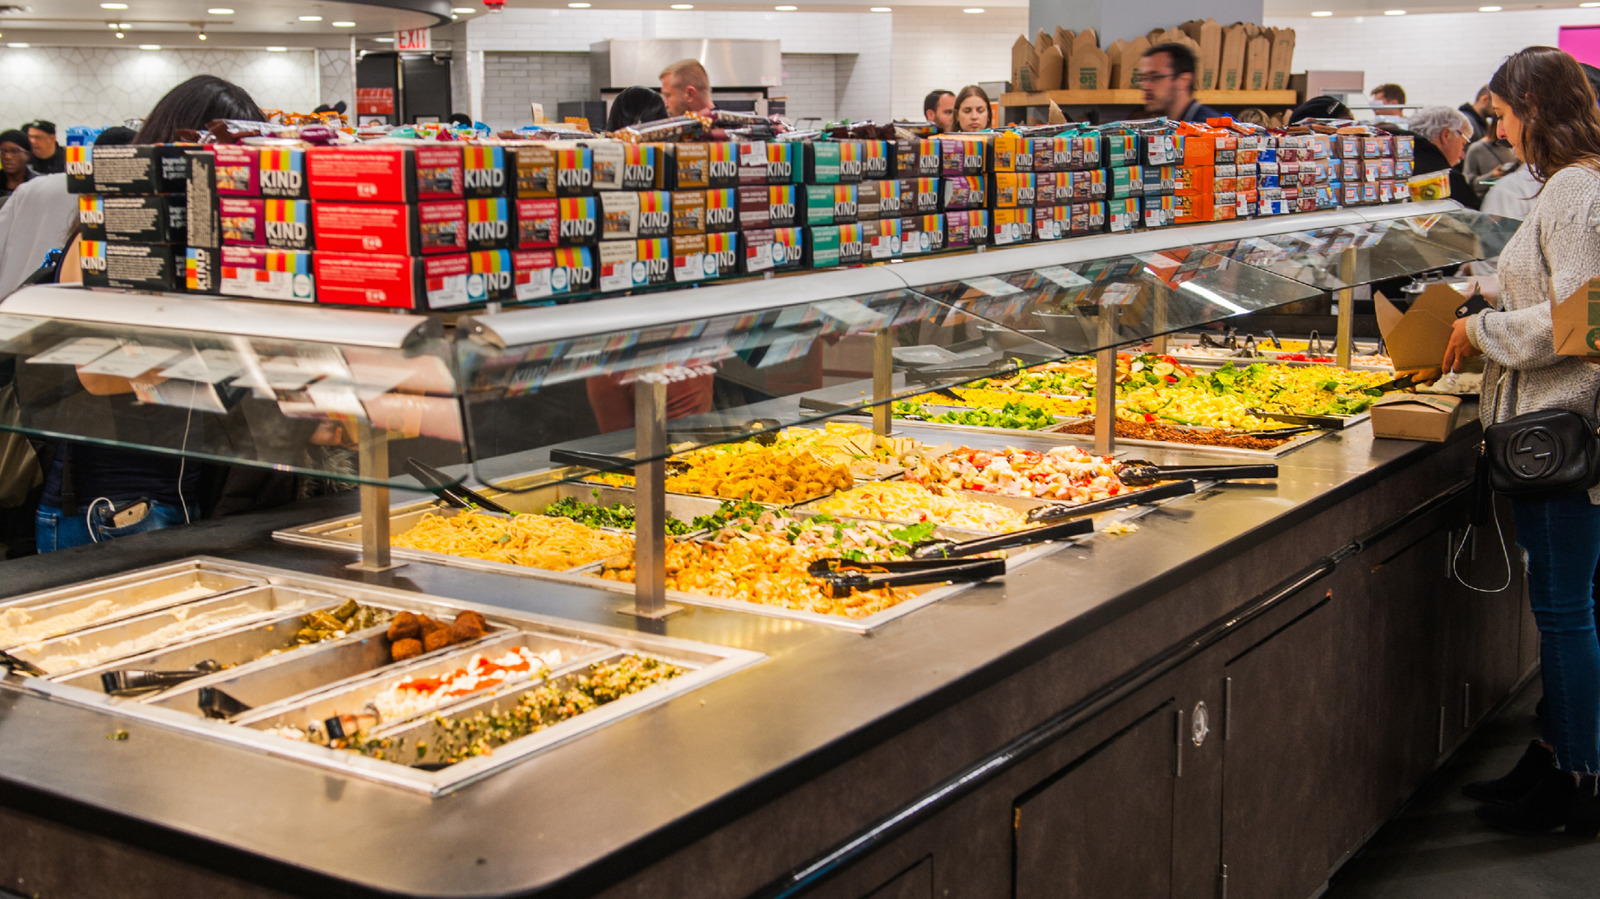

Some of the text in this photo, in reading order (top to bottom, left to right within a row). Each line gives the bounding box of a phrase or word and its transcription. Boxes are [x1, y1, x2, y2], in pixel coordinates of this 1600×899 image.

[398, 28, 428, 49] EXIT
[1015, 154, 1033, 166] KIND
[1054, 152, 1071, 164] KIND
[1084, 152, 1099, 163] KIND
[1124, 149, 1136, 159] KIND
[66, 161, 93, 175] KIND
[767, 161, 791, 176] KIND
[840, 161, 861, 175] KIND
[867, 157, 887, 171] KIND
[920, 155, 939, 168] KIND
[964, 155, 982, 168] KIND
[624, 165, 654, 180] KIND
[710, 161, 736, 177] KIND
[260, 170, 302, 188] KIND
[464, 169, 504, 188] KIND
[557, 168, 591, 187] KIND
[1130, 179, 1143, 190] KIND
[1161, 179, 1175, 189] KIND
[1018, 188, 1035, 199] KIND
[1056, 186, 1073, 198] KIND
[1092, 183, 1106, 194] KIND
[880, 197, 900, 211] KIND
[918, 192, 937, 206] KIND
[969, 191, 984, 204] KIND
[770, 204, 795, 219] KIND
[835, 201, 857, 215] KIND
[80, 211, 104, 224] KIND
[640, 212, 670, 228] KIND
[706, 208, 734, 224] KIND
[1089, 215, 1104, 226] KIND
[265, 221, 307, 240] KIND
[468, 221, 508, 241] KIND
[561, 218, 595, 237] KIND
[969, 226, 987, 238] KIND
[1020, 223, 1032, 234] IND
[930, 231, 943, 244] IND
[786, 246, 801, 260] IND
[840, 242, 862, 256] KIND
[81, 257, 106, 270] KIND
[717, 252, 735, 267] IND
[196, 248, 207, 290] KIND
[648, 259, 668, 275] IND
[484, 272, 511, 290] IND
[569, 266, 592, 284] IND
